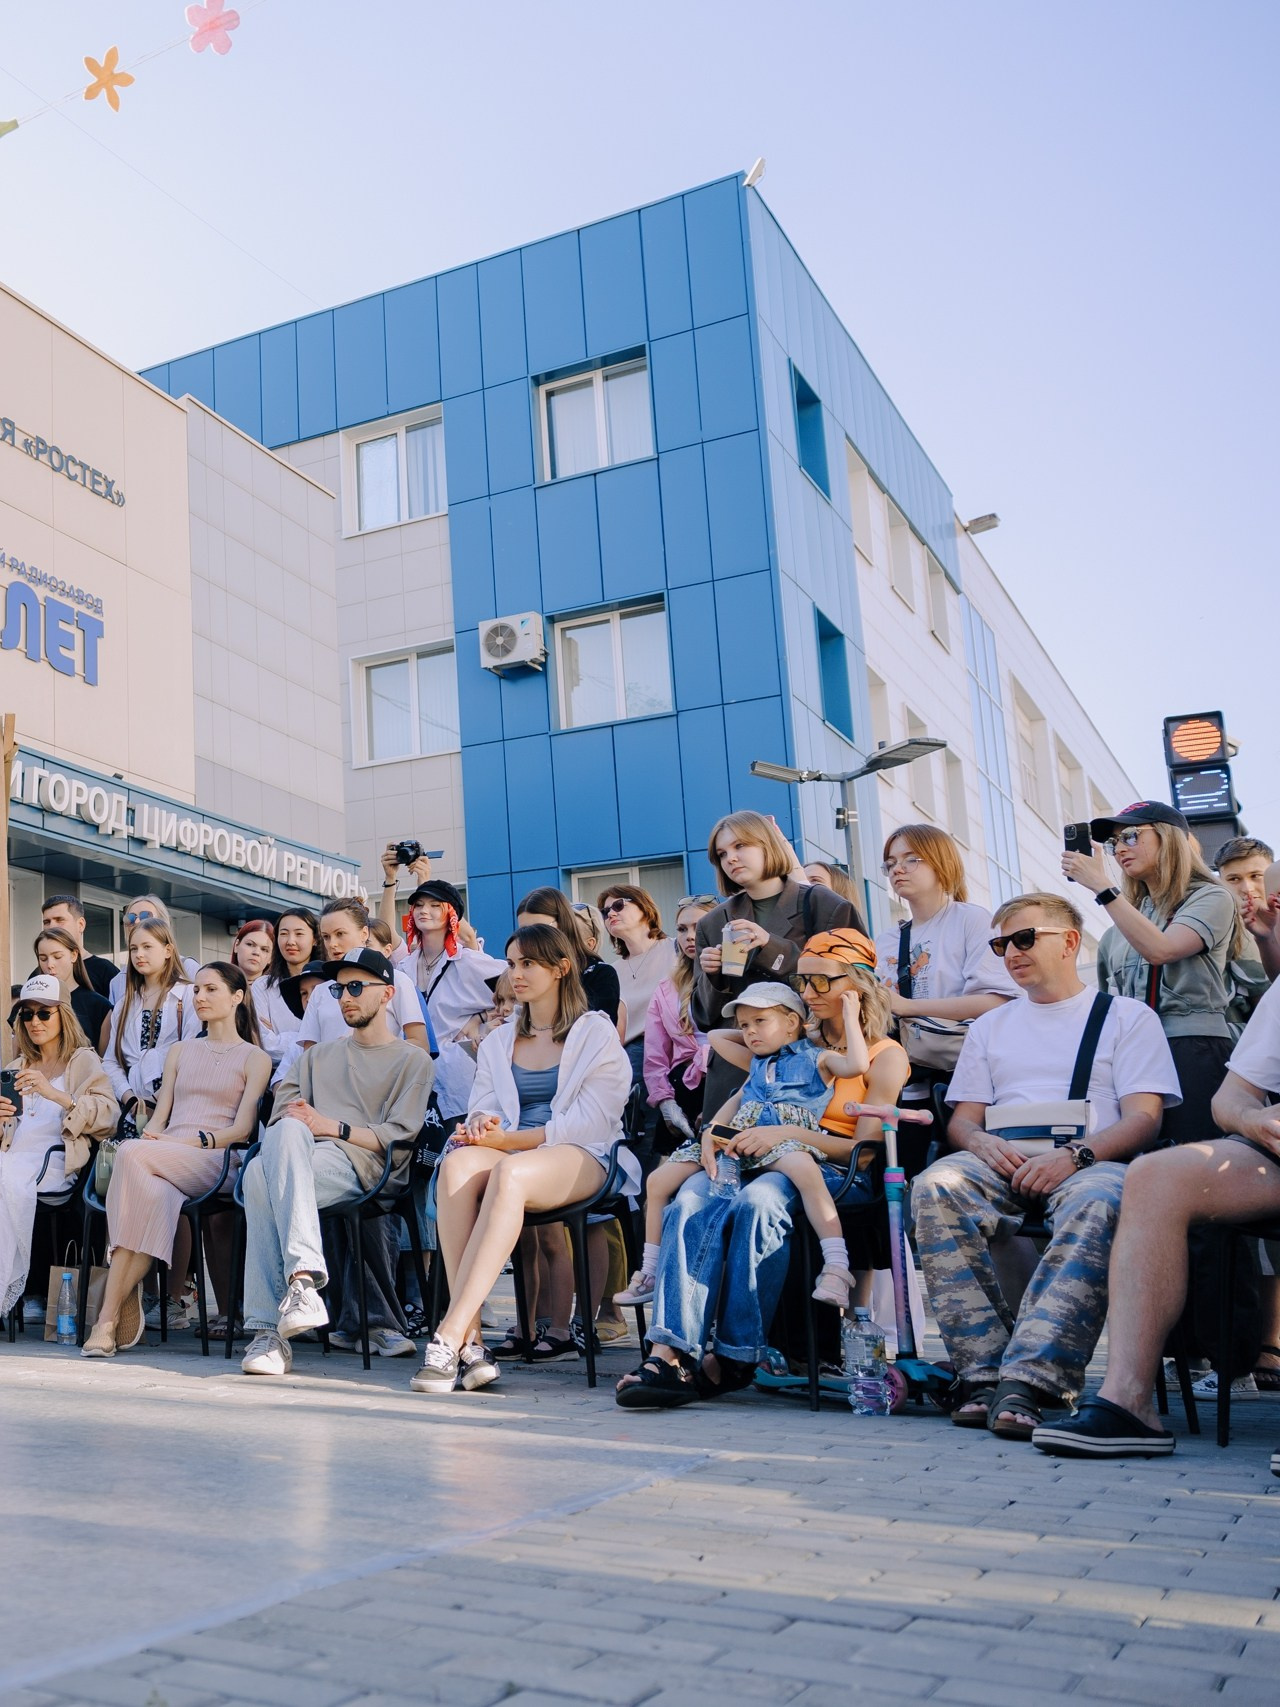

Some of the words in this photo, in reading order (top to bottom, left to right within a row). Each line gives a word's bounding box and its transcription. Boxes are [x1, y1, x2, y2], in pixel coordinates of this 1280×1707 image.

[24, 435, 125, 507] «РОСТЕХ»
[9, 557, 104, 617] РАДИОЗАВОД
[135, 803, 277, 881] ЦИФРОВОЙ
